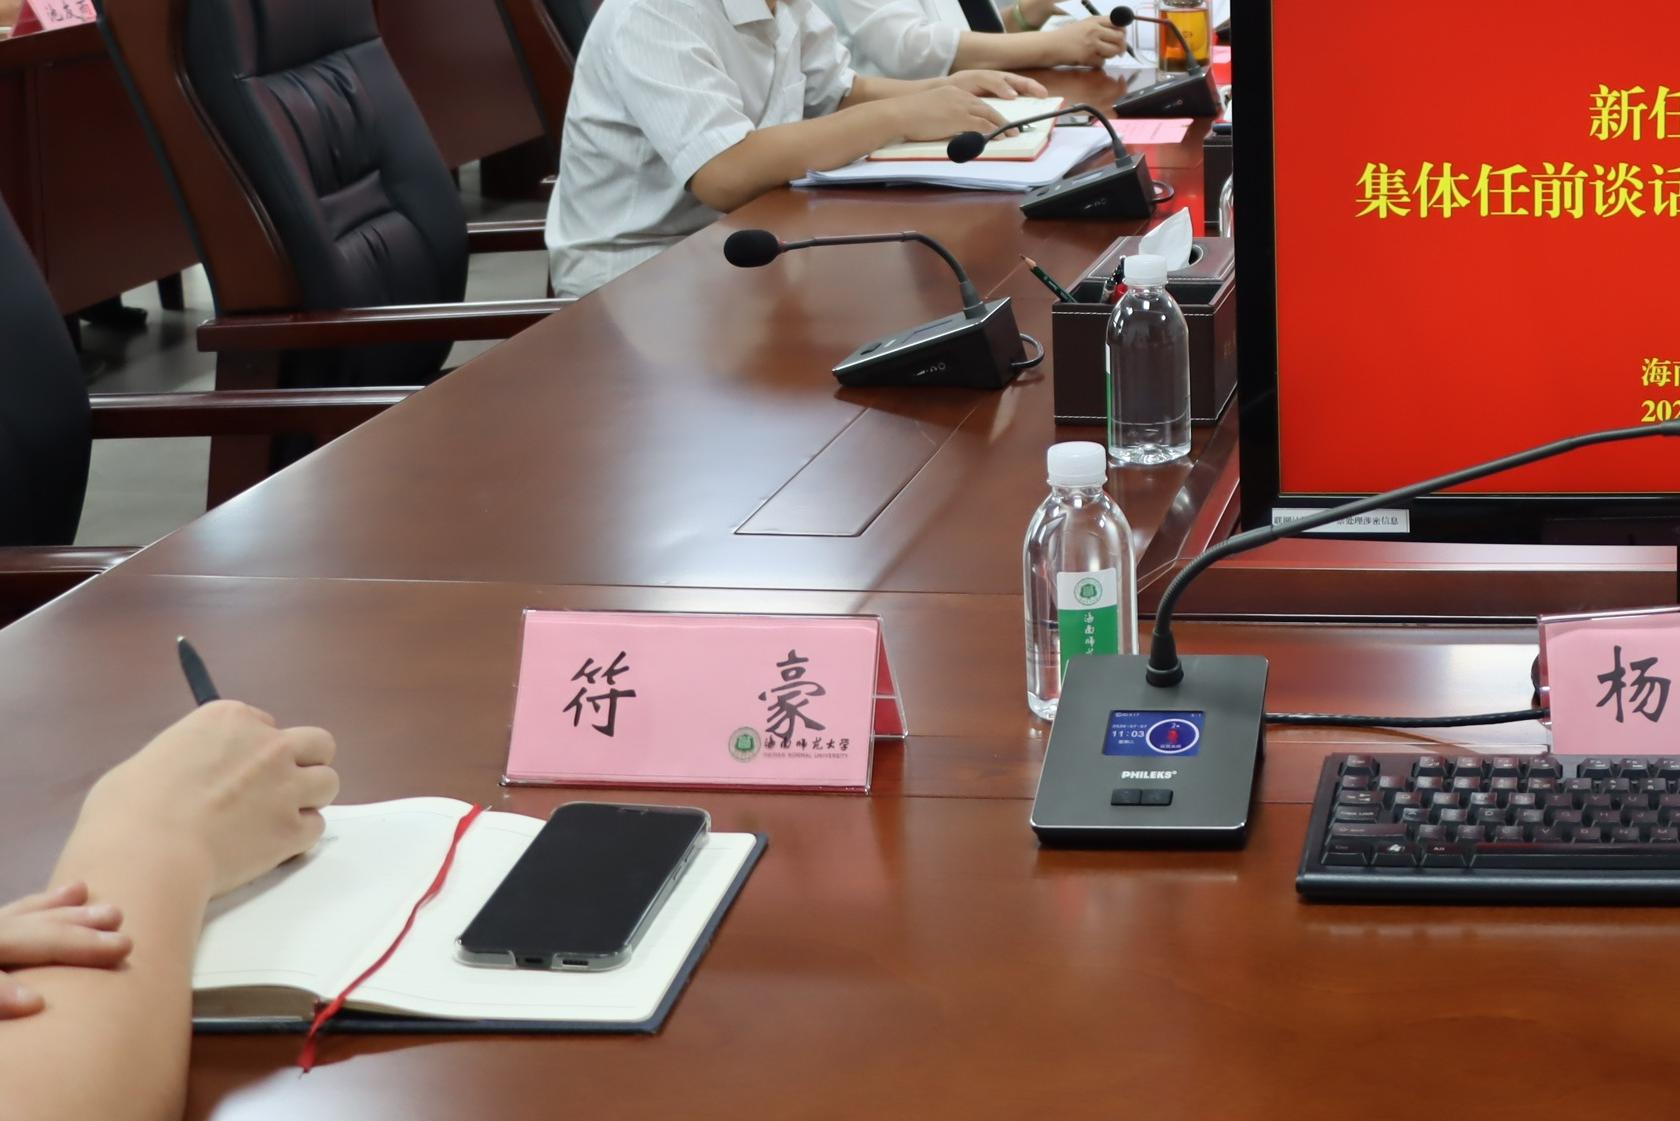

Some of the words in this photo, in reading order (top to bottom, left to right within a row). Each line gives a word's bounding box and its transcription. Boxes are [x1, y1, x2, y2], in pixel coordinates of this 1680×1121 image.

[563, 651, 637, 737] 符
[758, 649, 827, 741] 豪
[1596, 645, 1671, 723] 杨
[1112, 730, 1145, 738] 11:03
